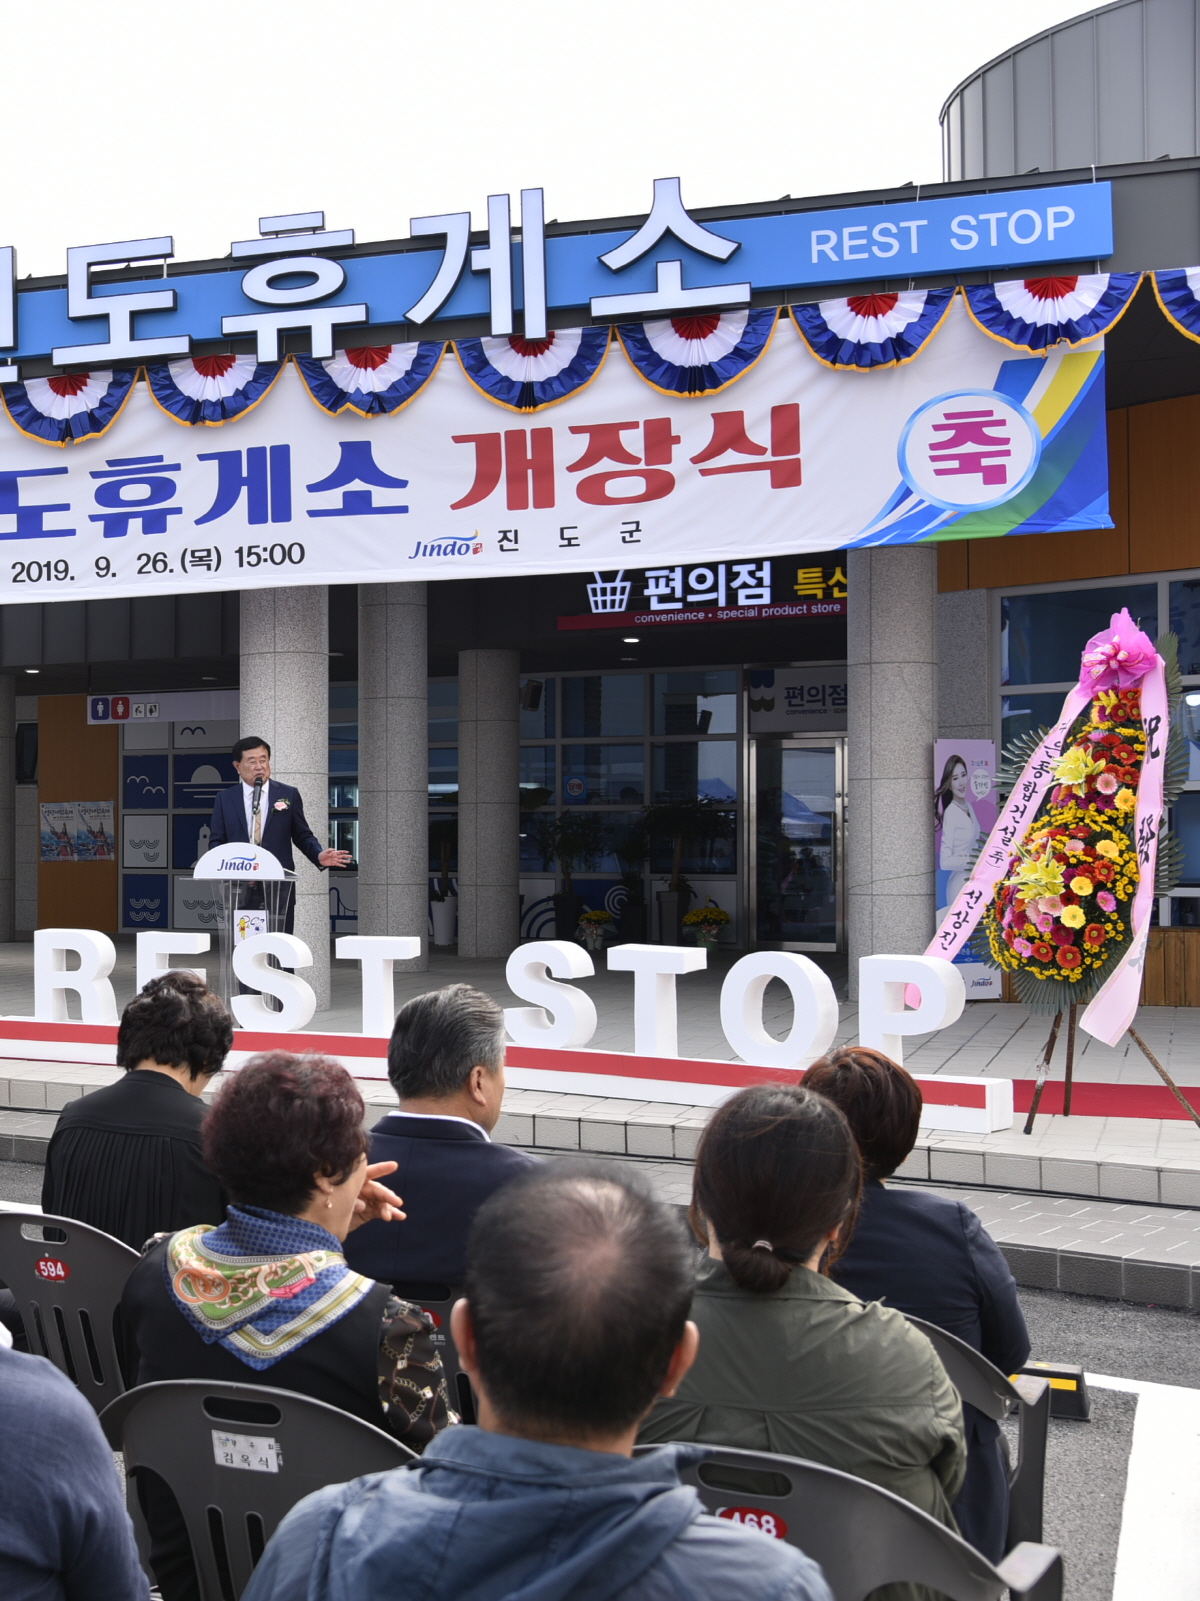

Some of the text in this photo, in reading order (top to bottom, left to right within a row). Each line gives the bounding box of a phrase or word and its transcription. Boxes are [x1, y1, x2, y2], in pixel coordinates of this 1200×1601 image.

[809, 205, 1076, 264] REST STOP
[449, 403, 802, 511] 개장식
[927, 409, 1012, 486] 축
[408, 541, 471, 560] Jindo
[11, 561, 76, 584] 2019.
[94, 556, 117, 578] 9.
[234, 542, 306, 569] 15:00
[644, 561, 771, 611] 편의점
[634, 602, 841, 624] convenience special product store
[784, 684, 848, 707] 편의점
[786, 708, 827, 716] convenience
[217, 859, 252, 872] Jindo
[970, 980, 989, 988] Jindo
[504, 940, 966, 1066] STOP
[39, 1261, 65, 1277] 594
